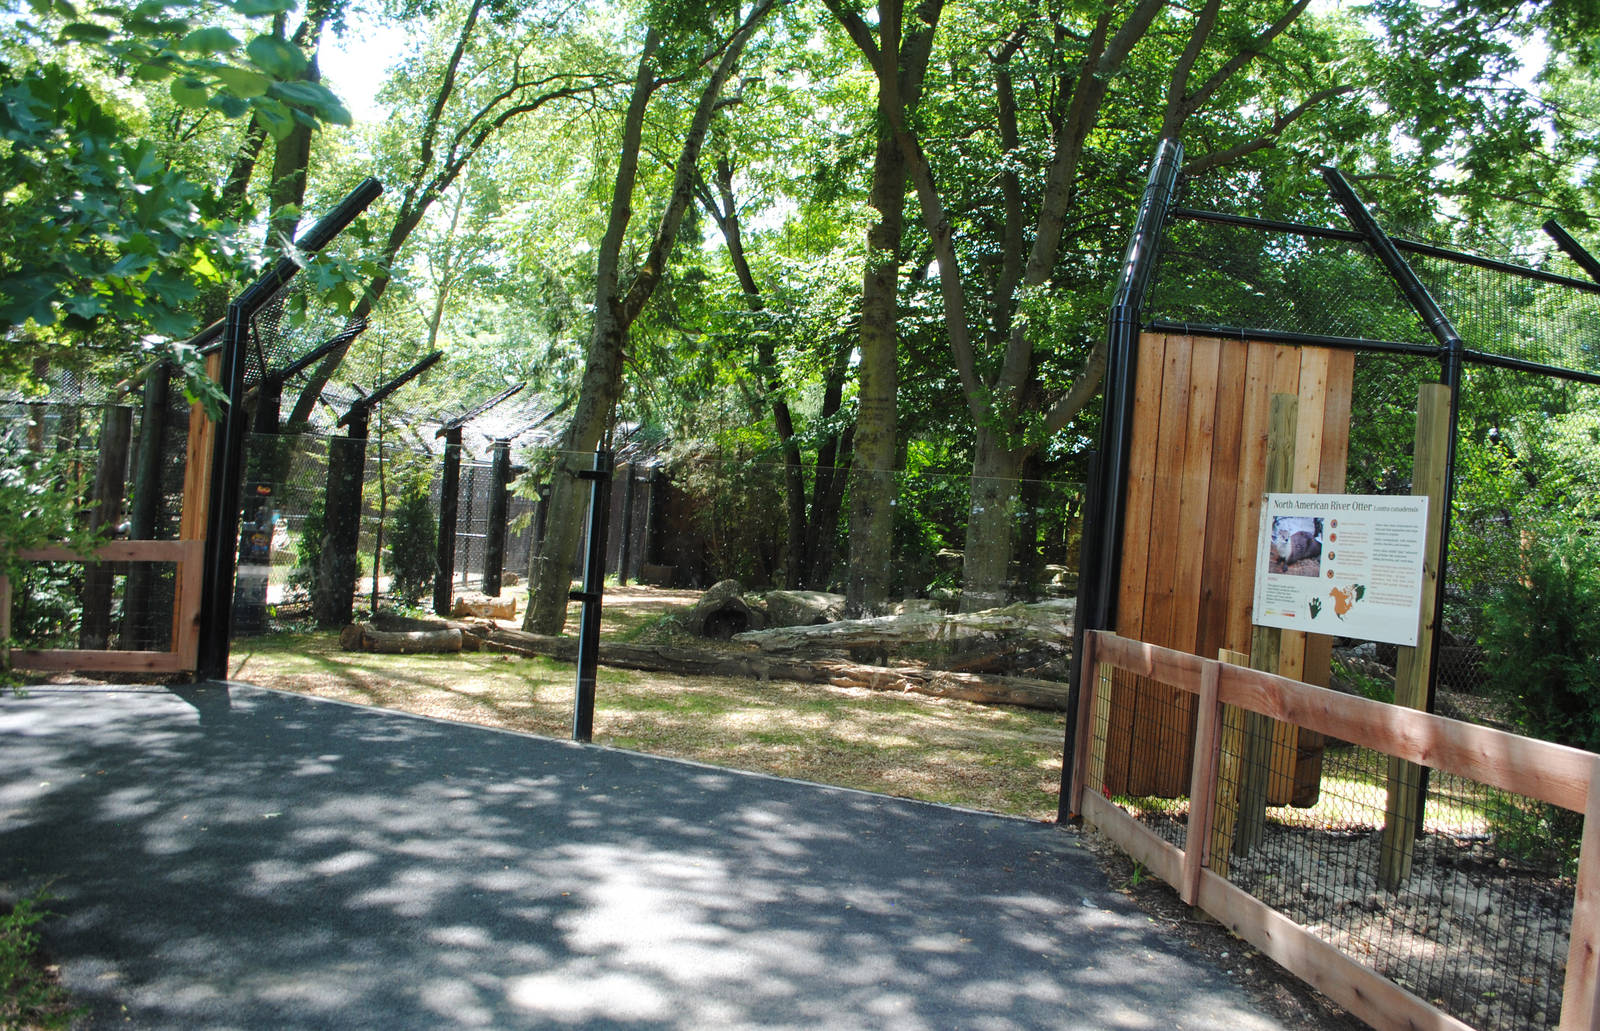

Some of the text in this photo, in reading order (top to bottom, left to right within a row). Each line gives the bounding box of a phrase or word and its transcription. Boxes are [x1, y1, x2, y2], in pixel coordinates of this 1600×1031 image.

[1274, 499, 1293, 509] North
[1294, 500, 1329, 510] American
[1331, 501, 1350, 510] River
[1352, 501, 1373, 511] Otter
